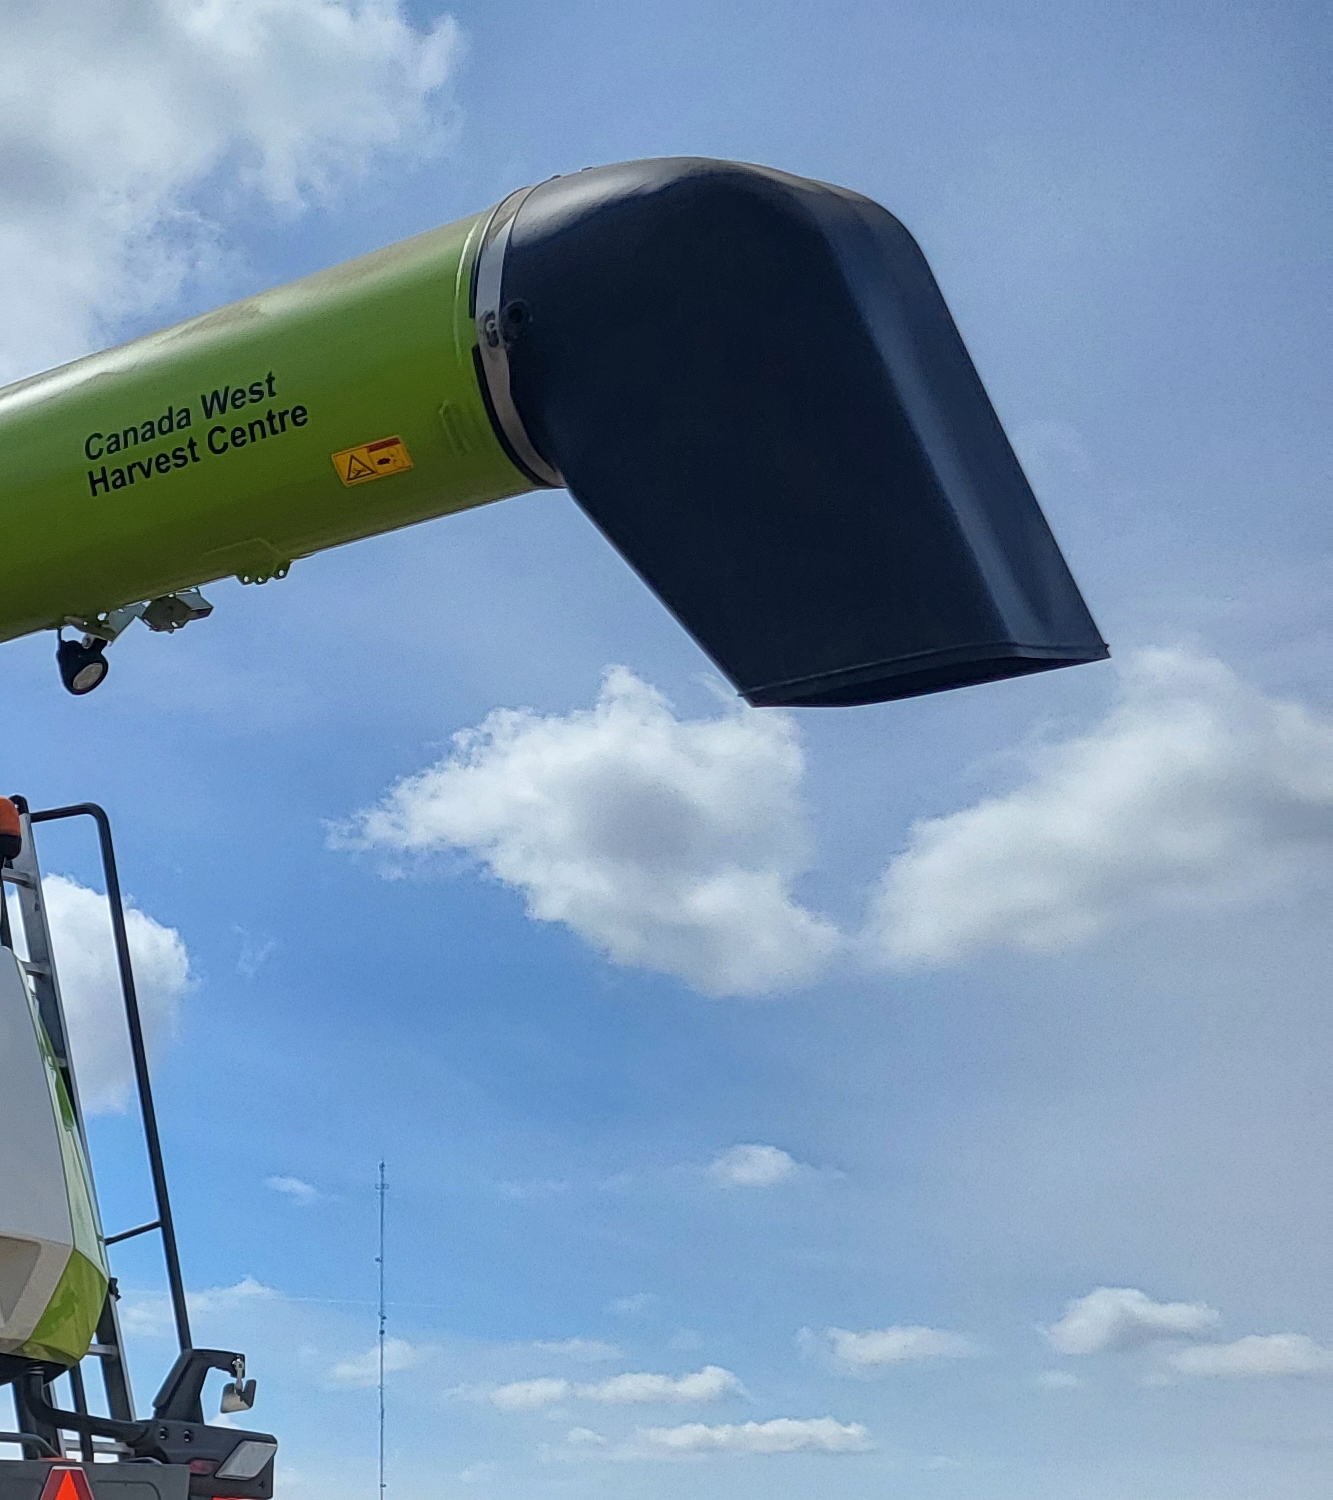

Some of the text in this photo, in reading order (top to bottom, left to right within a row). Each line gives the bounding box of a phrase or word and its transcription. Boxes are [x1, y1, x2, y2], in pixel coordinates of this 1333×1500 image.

[85, 371, 277, 461] Canada West
[87, 404, 309, 497] Harvest Centre
